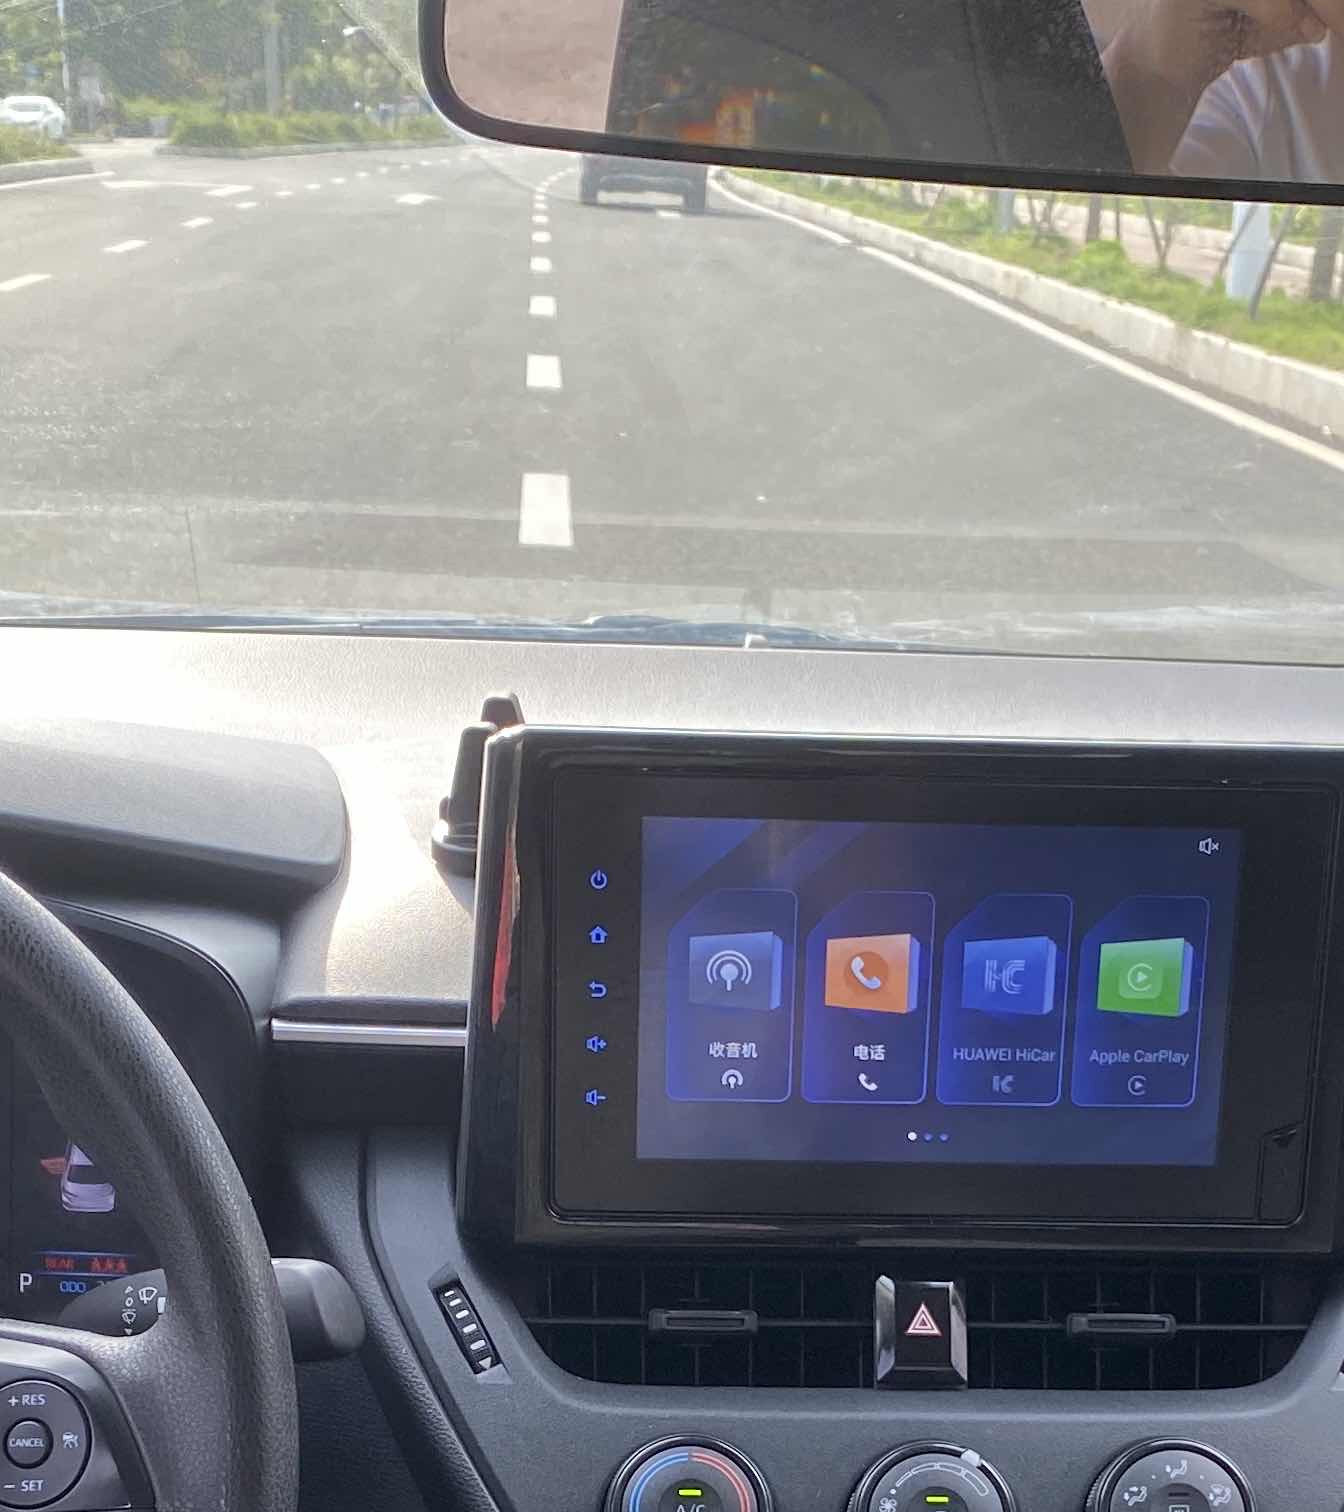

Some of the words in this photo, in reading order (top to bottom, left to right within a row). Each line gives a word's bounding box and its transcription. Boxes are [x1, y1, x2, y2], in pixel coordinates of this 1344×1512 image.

[709, 1042, 758, 1058] 收音机
[854, 1045, 886, 1060] 电话
[953, 1048, 1011, 1061] HUAWEI
[1016, 1048, 1056, 1062] HiCar
[1089, 1050, 1129, 1065] Apple
[1134, 1051, 1189, 1066] CarPlay
[19, 1273, 33, 1294] P
[9, 1438, 44, 1448] CANCEL
